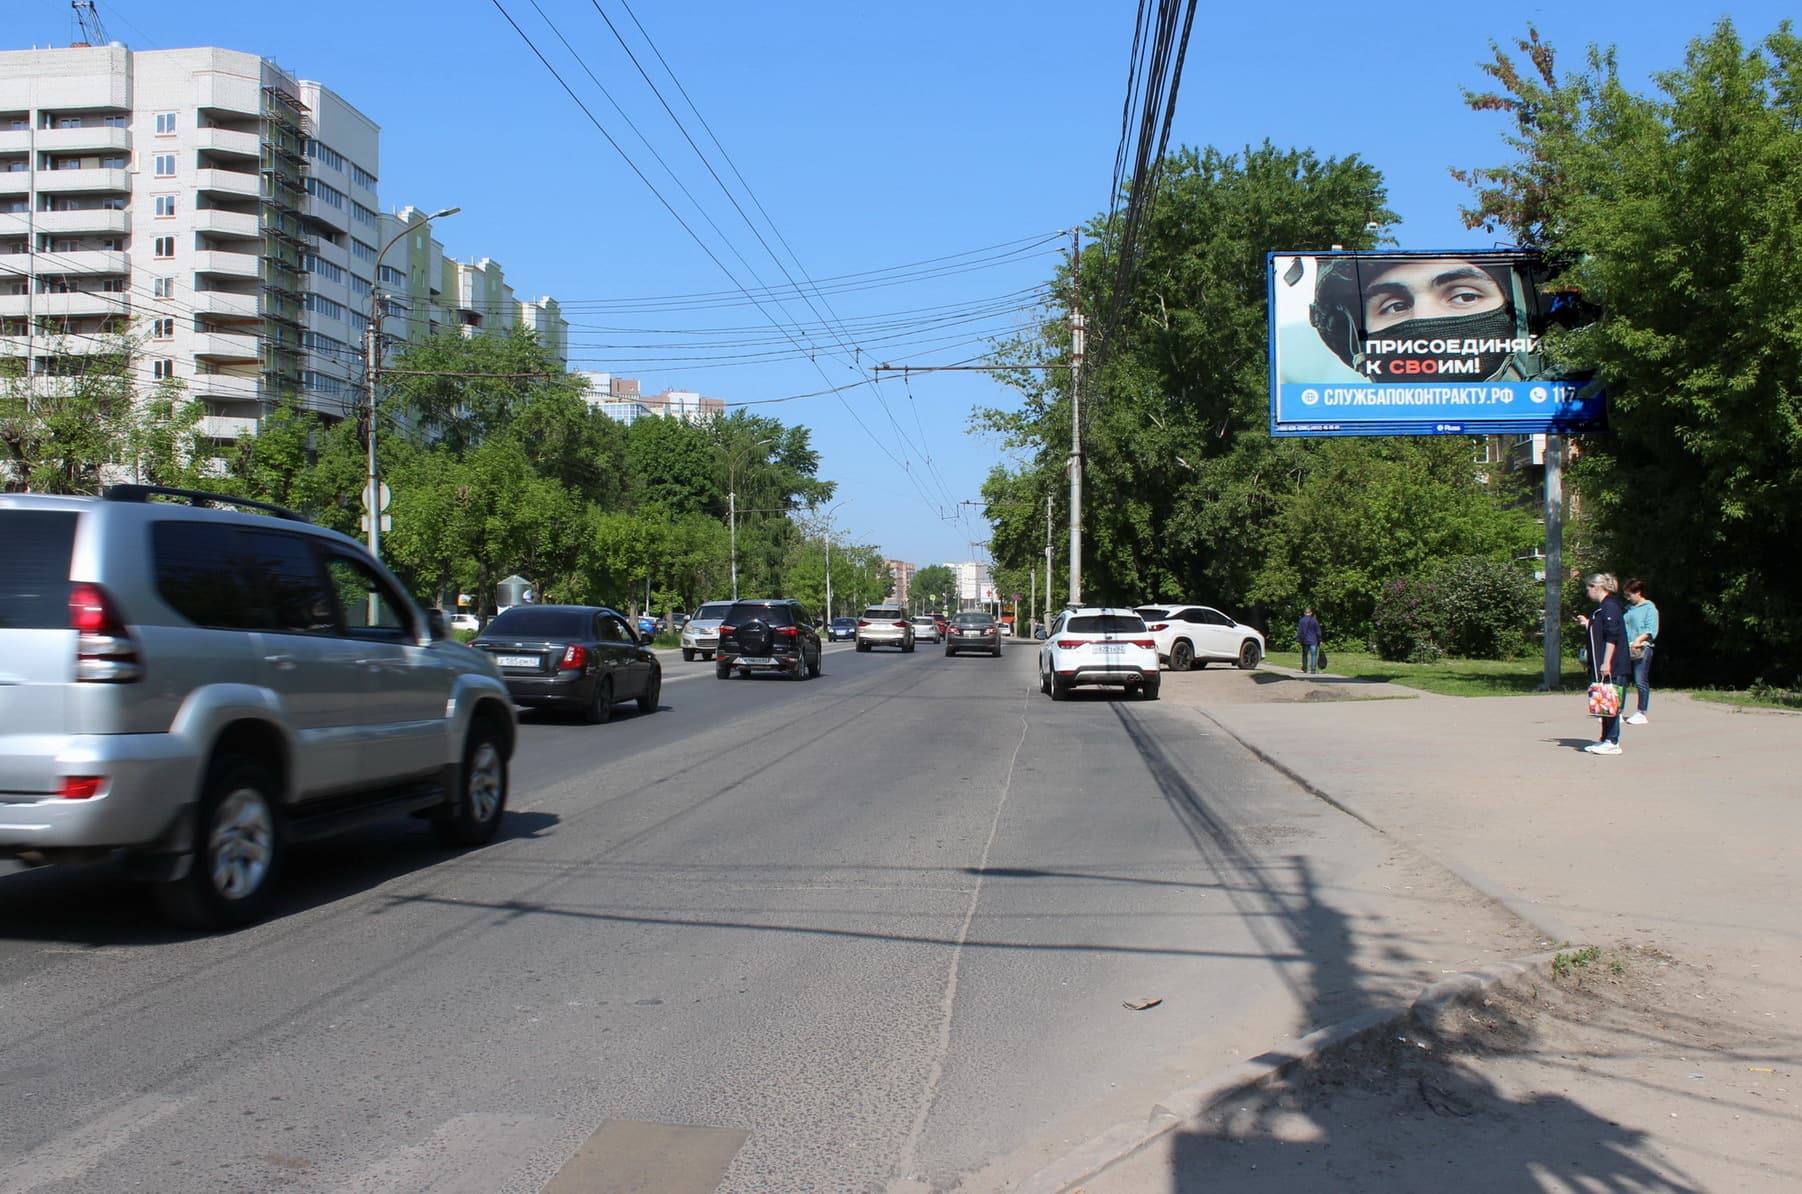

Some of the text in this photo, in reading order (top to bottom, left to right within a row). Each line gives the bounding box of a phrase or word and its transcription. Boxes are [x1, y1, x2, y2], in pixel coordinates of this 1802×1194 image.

[1366, 334, 1545, 355] ПРИСОЕДИНЯЙ
[1366, 359, 1481, 375] К СВОИМ!
[1324, 387, 1514, 405] СЛУЖБАПОКОНТРАКТУ.РФ
[1552, 386, 1576, 403] 117
